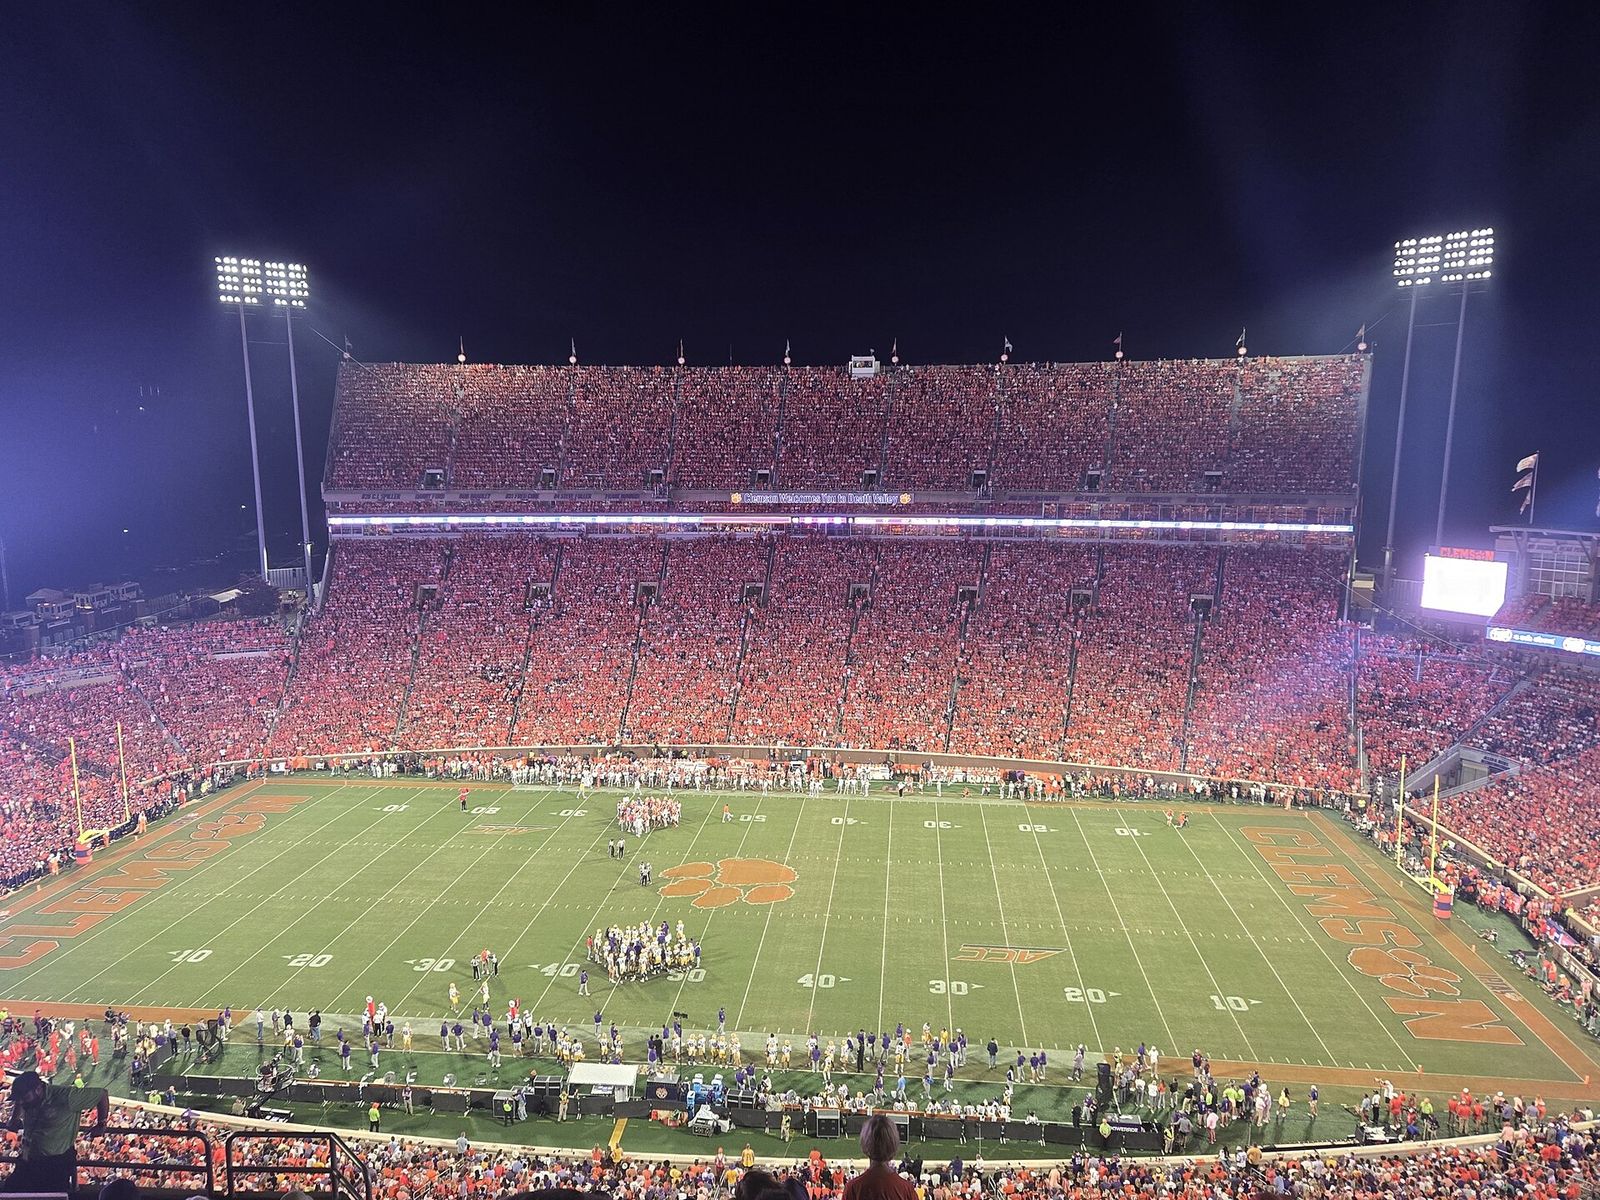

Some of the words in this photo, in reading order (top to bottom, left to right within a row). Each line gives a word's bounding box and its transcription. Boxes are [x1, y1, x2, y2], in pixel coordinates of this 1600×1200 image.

[744, 493, 778, 504] Clemson
[779, 493, 820, 504] Welcomes
[821, 493, 836, 504] You
[837, 493, 846, 504] to
[848, 493, 872, 504] Death
[873, 493, 898, 506] Valley
[739, 814, 767, 823] 50
[923, 820, 951, 829] 30
[1018, 823, 1048, 833] 20
[1115, 827, 1142, 836] 10
[171, 949, 214, 963] 10
[287, 953, 334, 968] 20
[412, 958, 456, 973] 30
[539, 963, 582, 978] 40
[797, 973, 836, 988] 40
[928, 979, 969, 996] 30
[1063, 986, 1107, 1004] 20
[1209, 995, 1250, 1012] 10
